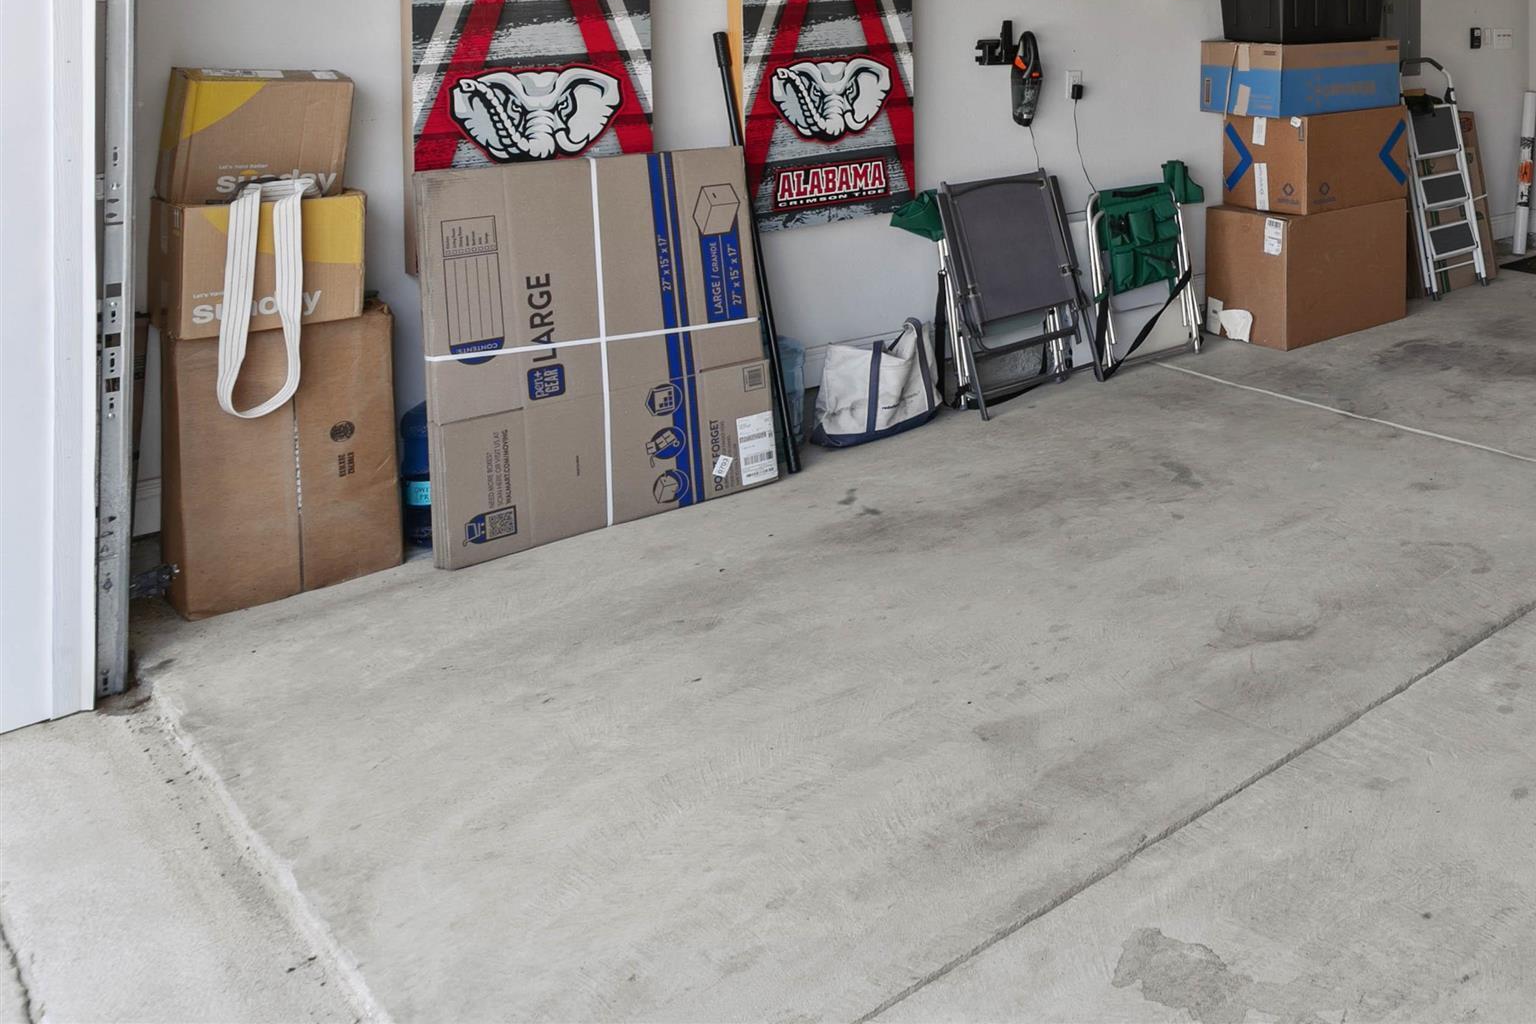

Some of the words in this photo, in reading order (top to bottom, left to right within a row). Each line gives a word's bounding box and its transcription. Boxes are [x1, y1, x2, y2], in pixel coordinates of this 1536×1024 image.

[216, 168, 337, 194] sday
[777, 161, 886, 201] ALABAMA
[778, 194, 848, 207] CRIMSON
[709, 242, 719, 273] GRANDE
[192, 290, 322, 325] sdy
[711, 281, 723, 315] LARGE
[526, 273, 557, 362] LARGE
[709, 419, 721, 459] FORGET
